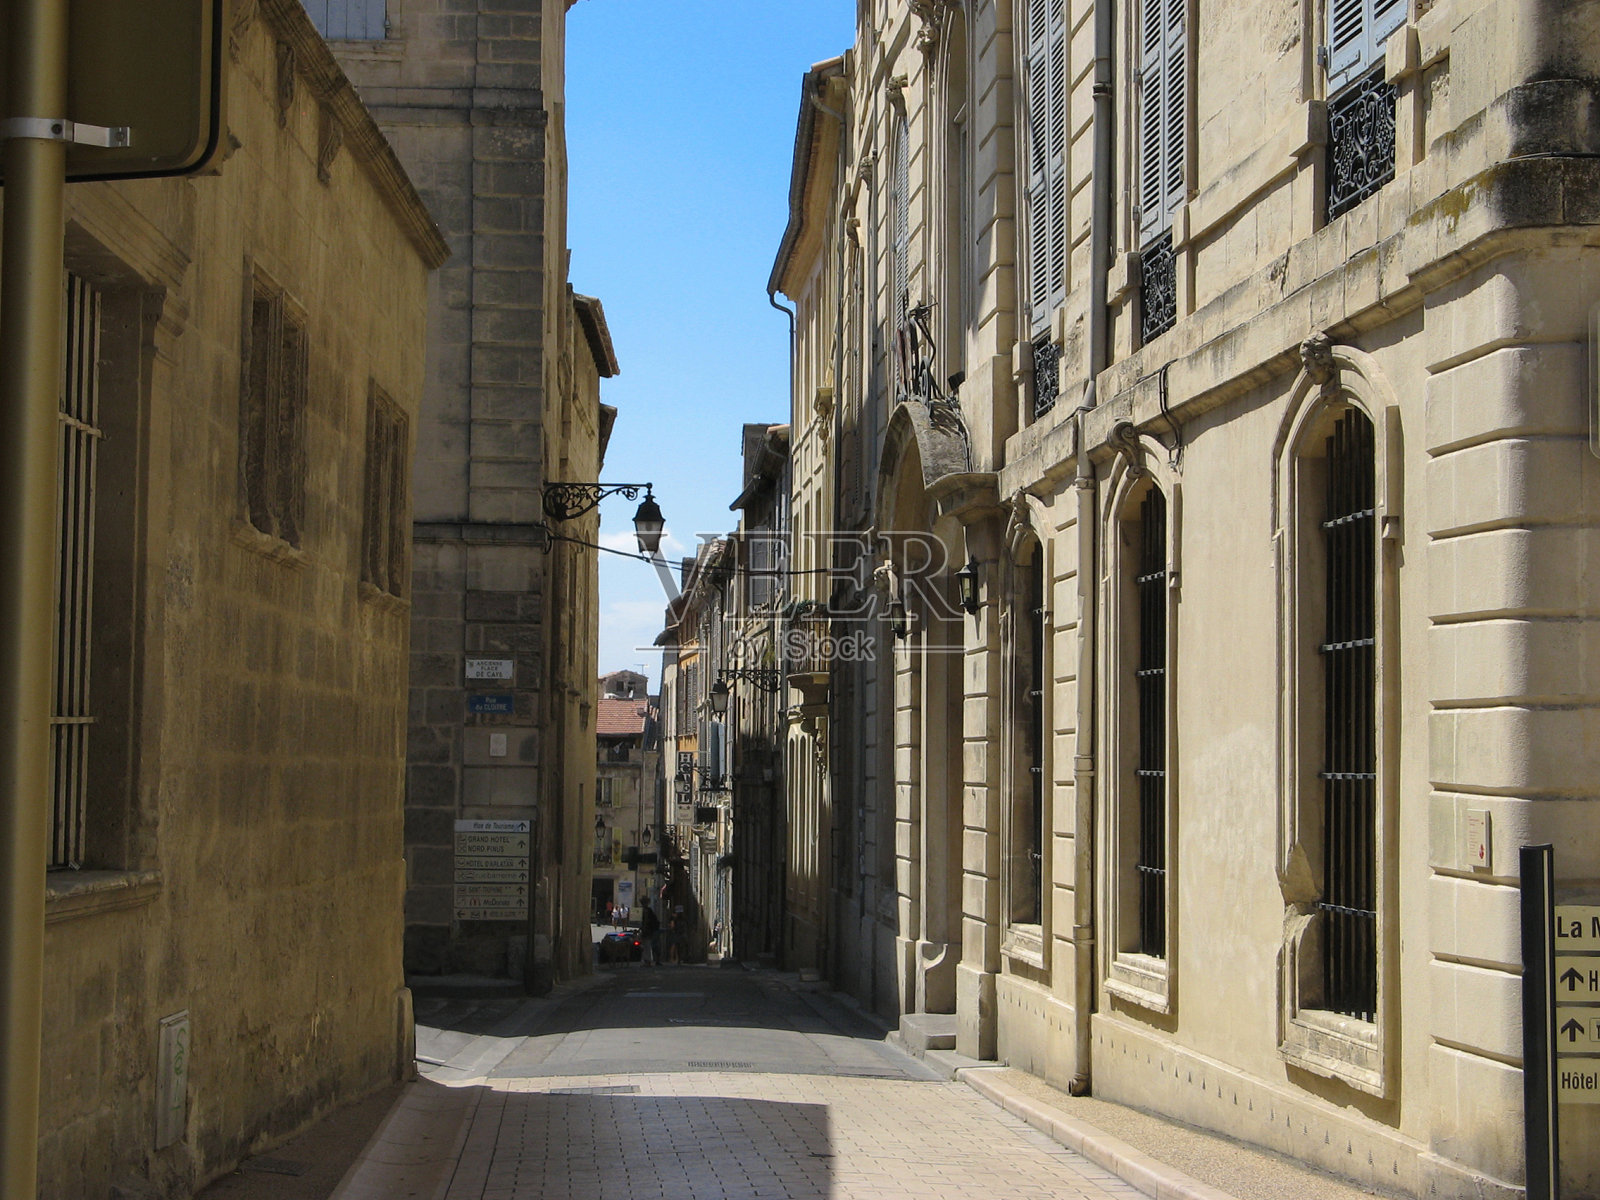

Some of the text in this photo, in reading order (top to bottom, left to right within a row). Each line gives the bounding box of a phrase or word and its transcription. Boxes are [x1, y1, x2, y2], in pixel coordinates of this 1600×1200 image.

[490, 836, 510, 844] HOTEL
[467, 845, 504, 853] NORD PINUS
[1557, 916, 1583, 938] La
[1561, 1071, 1598, 1090] Hôtel
